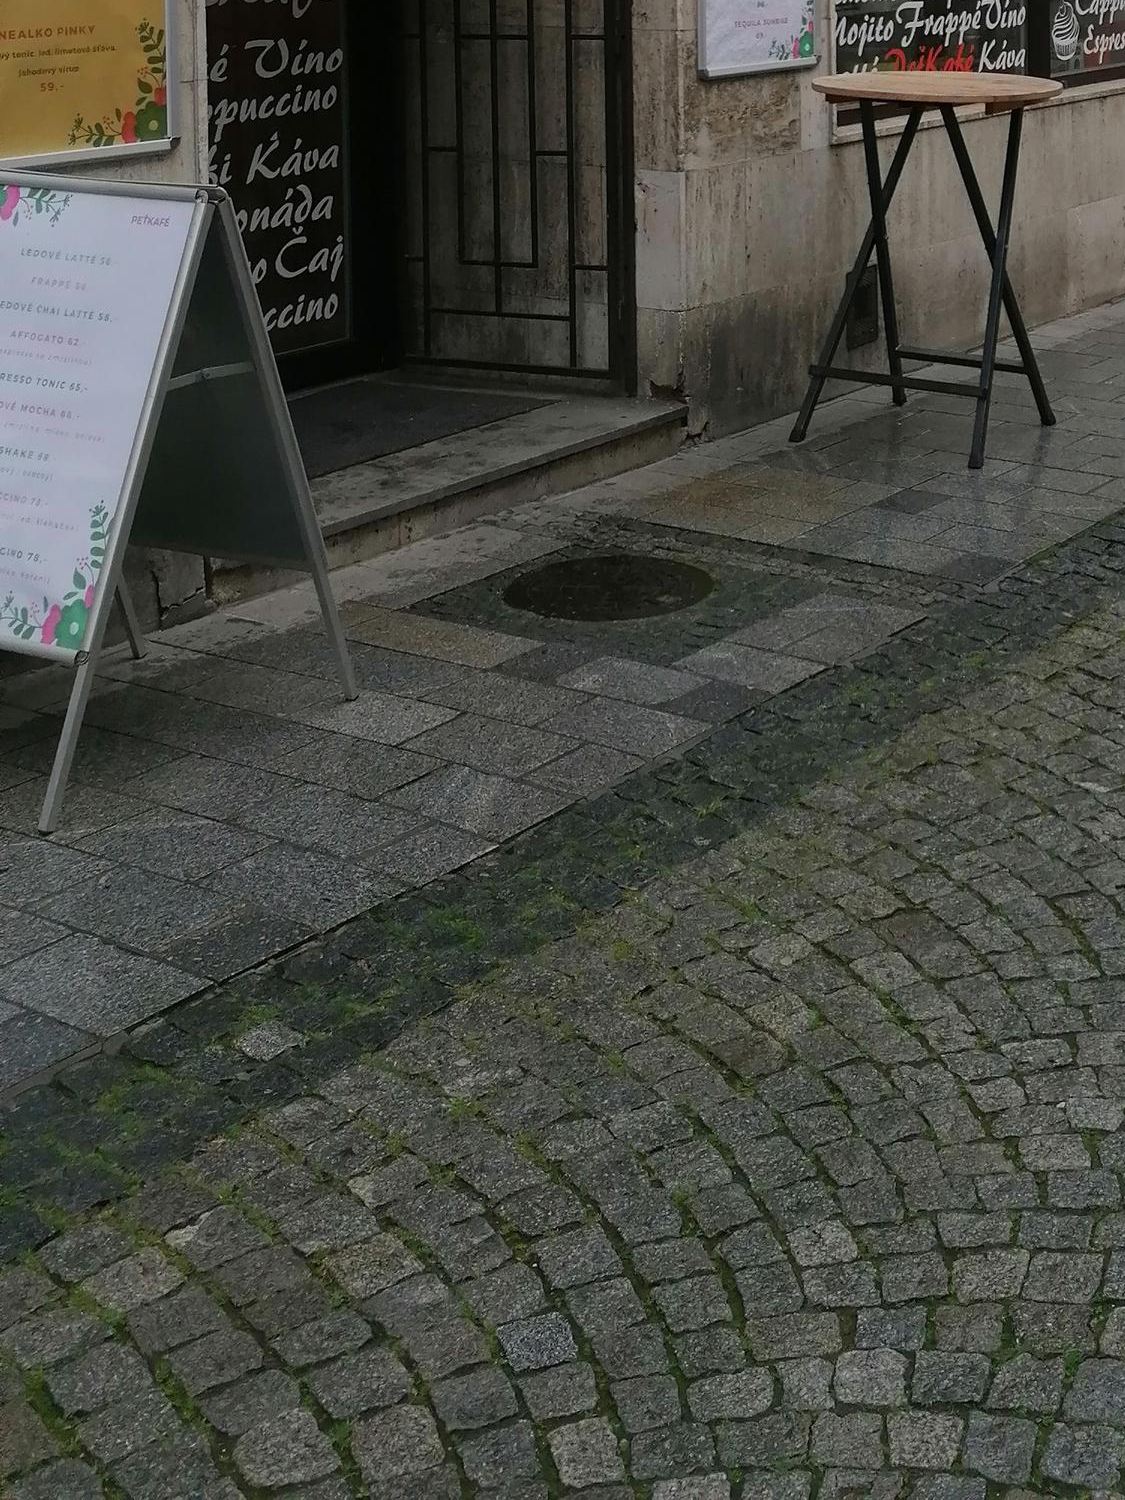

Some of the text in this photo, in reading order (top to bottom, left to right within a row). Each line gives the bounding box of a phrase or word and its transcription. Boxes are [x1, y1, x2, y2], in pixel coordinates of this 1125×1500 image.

[56, 25, 96, 37] PINKY
[896, 0, 981, 47] Frappé
[244, 39, 344, 79] Víno
[978, 39, 1026, 73] Káva
[237, 184, 332, 234] onáda
[275, 226, 344, 283] Čaj
[0, 300, 33, 313] EDOVÉ
[36, 304, 60, 316] CHAI
[10, 330, 64, 345] AFFOGATO
[0, 372, 32, 385] RESSO
[36, 378, 66, 389] TONIC
[20, 404, 56, 417] MOCHA
[0, 446, 34, 460] SHAKE
